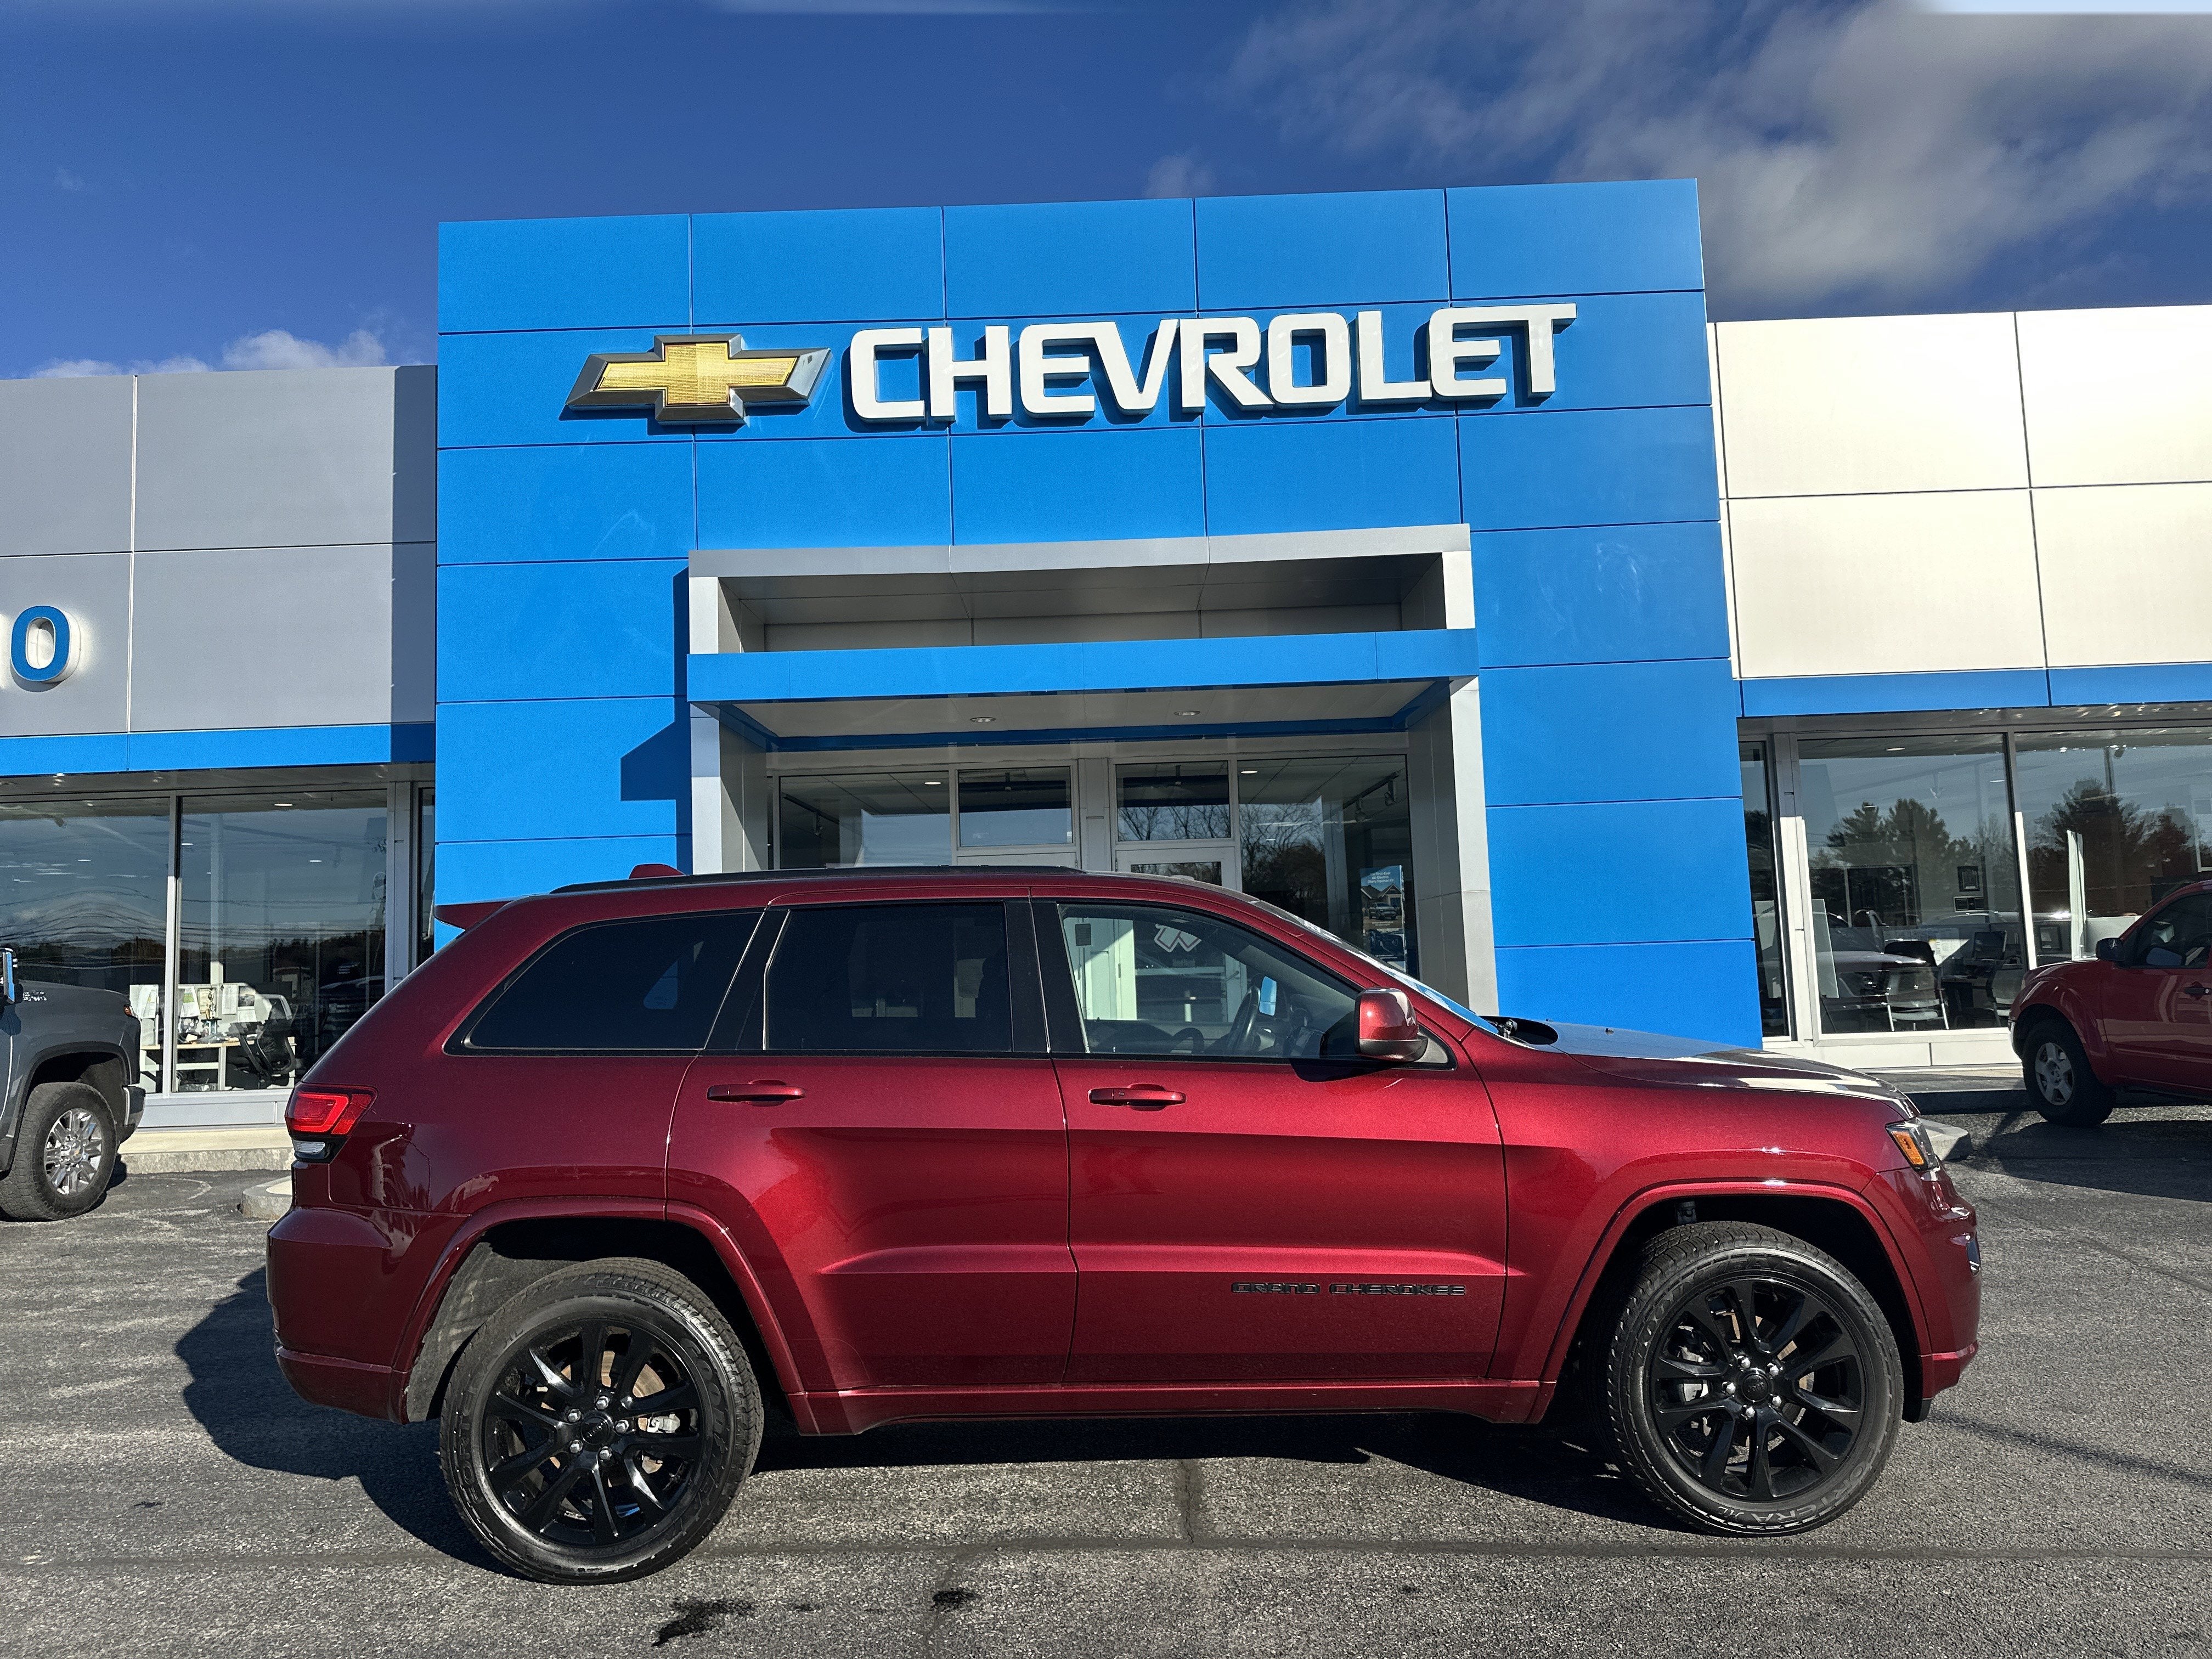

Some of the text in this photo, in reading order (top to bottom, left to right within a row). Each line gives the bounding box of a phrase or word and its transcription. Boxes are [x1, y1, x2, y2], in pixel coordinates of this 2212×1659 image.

[850, 303, 1577, 423] CHEVROLET
[10, 605, 77, 683] O
[1232, 1282, 1466, 1296] GRAND CHEROKEE
[1751, 1441, 1874, 1524] FORTERA
